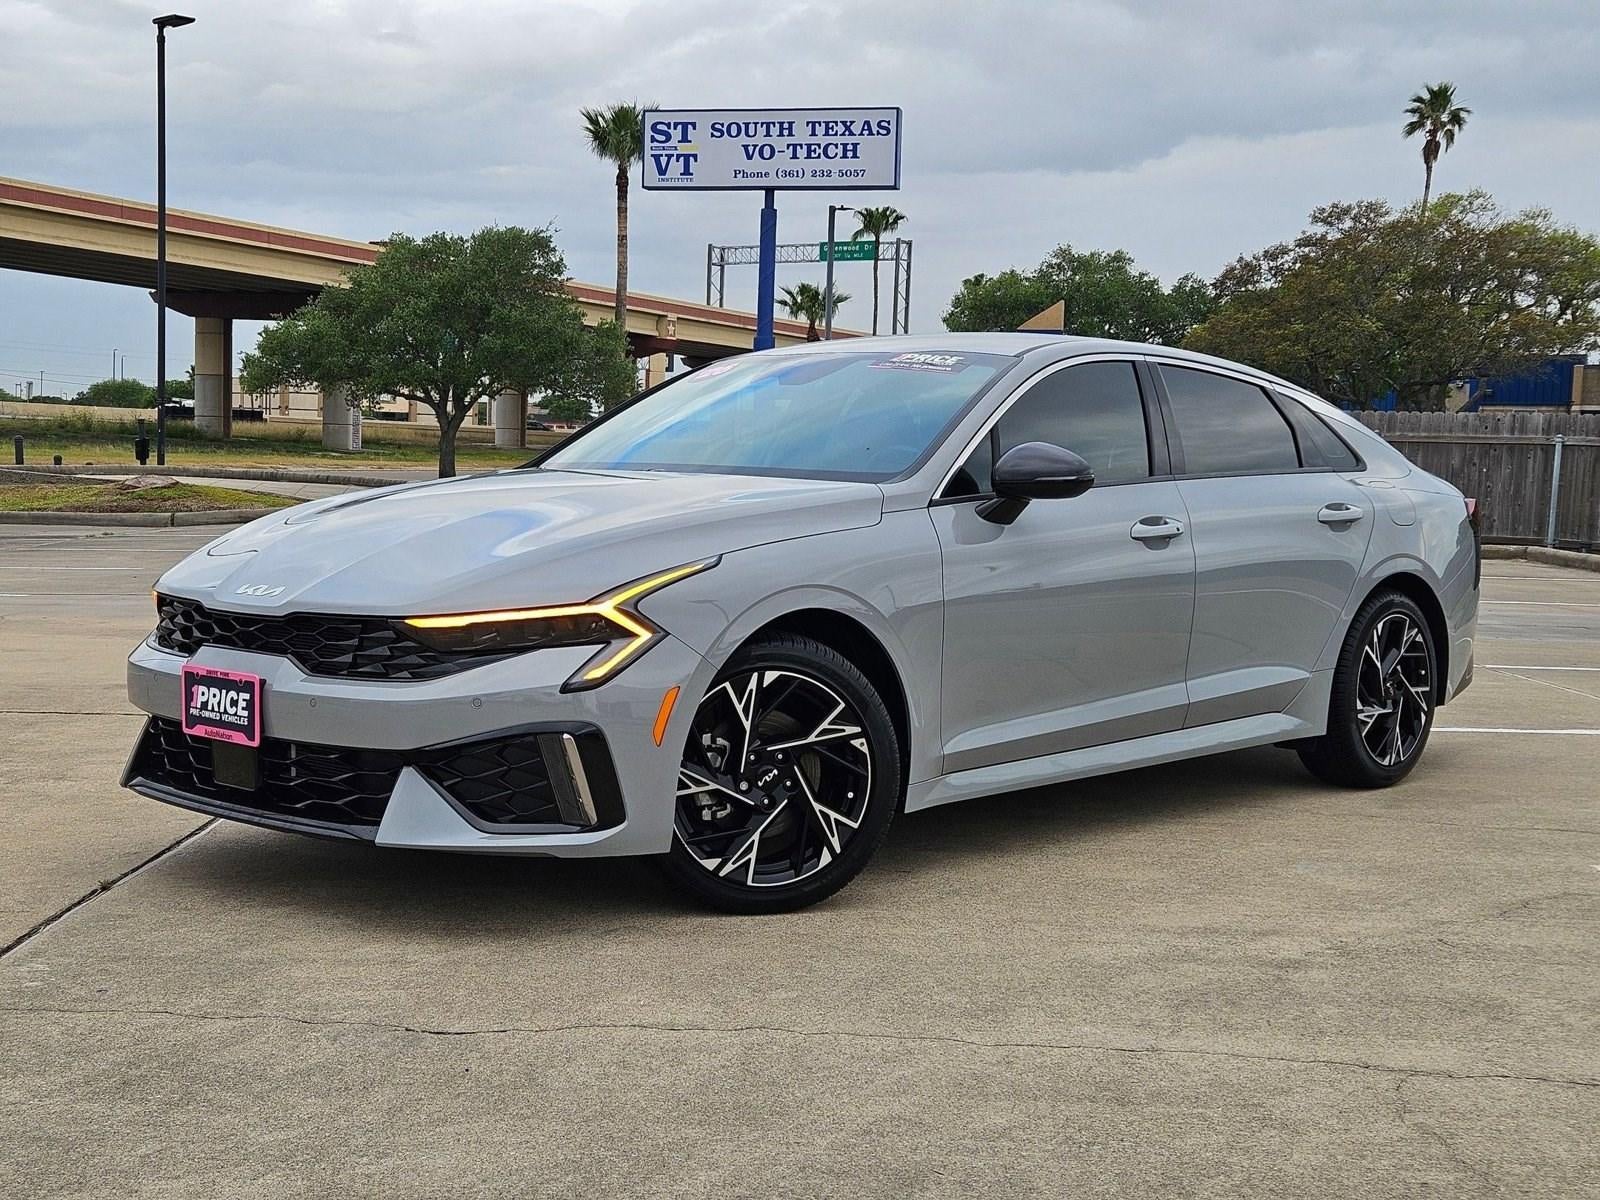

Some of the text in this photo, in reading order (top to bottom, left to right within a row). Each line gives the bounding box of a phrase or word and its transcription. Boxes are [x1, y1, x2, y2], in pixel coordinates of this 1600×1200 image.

[650, 121, 697, 144] ST
[710, 119, 892, 139] SOUTH TEXAS
[742, 142, 861, 161] VO-TECH
[650, 153, 698, 177] VT
[733, 168, 867, 179] Phone (361) 232-5057
[864, 243, 872, 251] Dr
[190, 684, 251, 717] 1PRICE
[189, 707, 249, 726] PRE-OWNED VEHICLES
[204, 728, 233, 741] AutoNation
